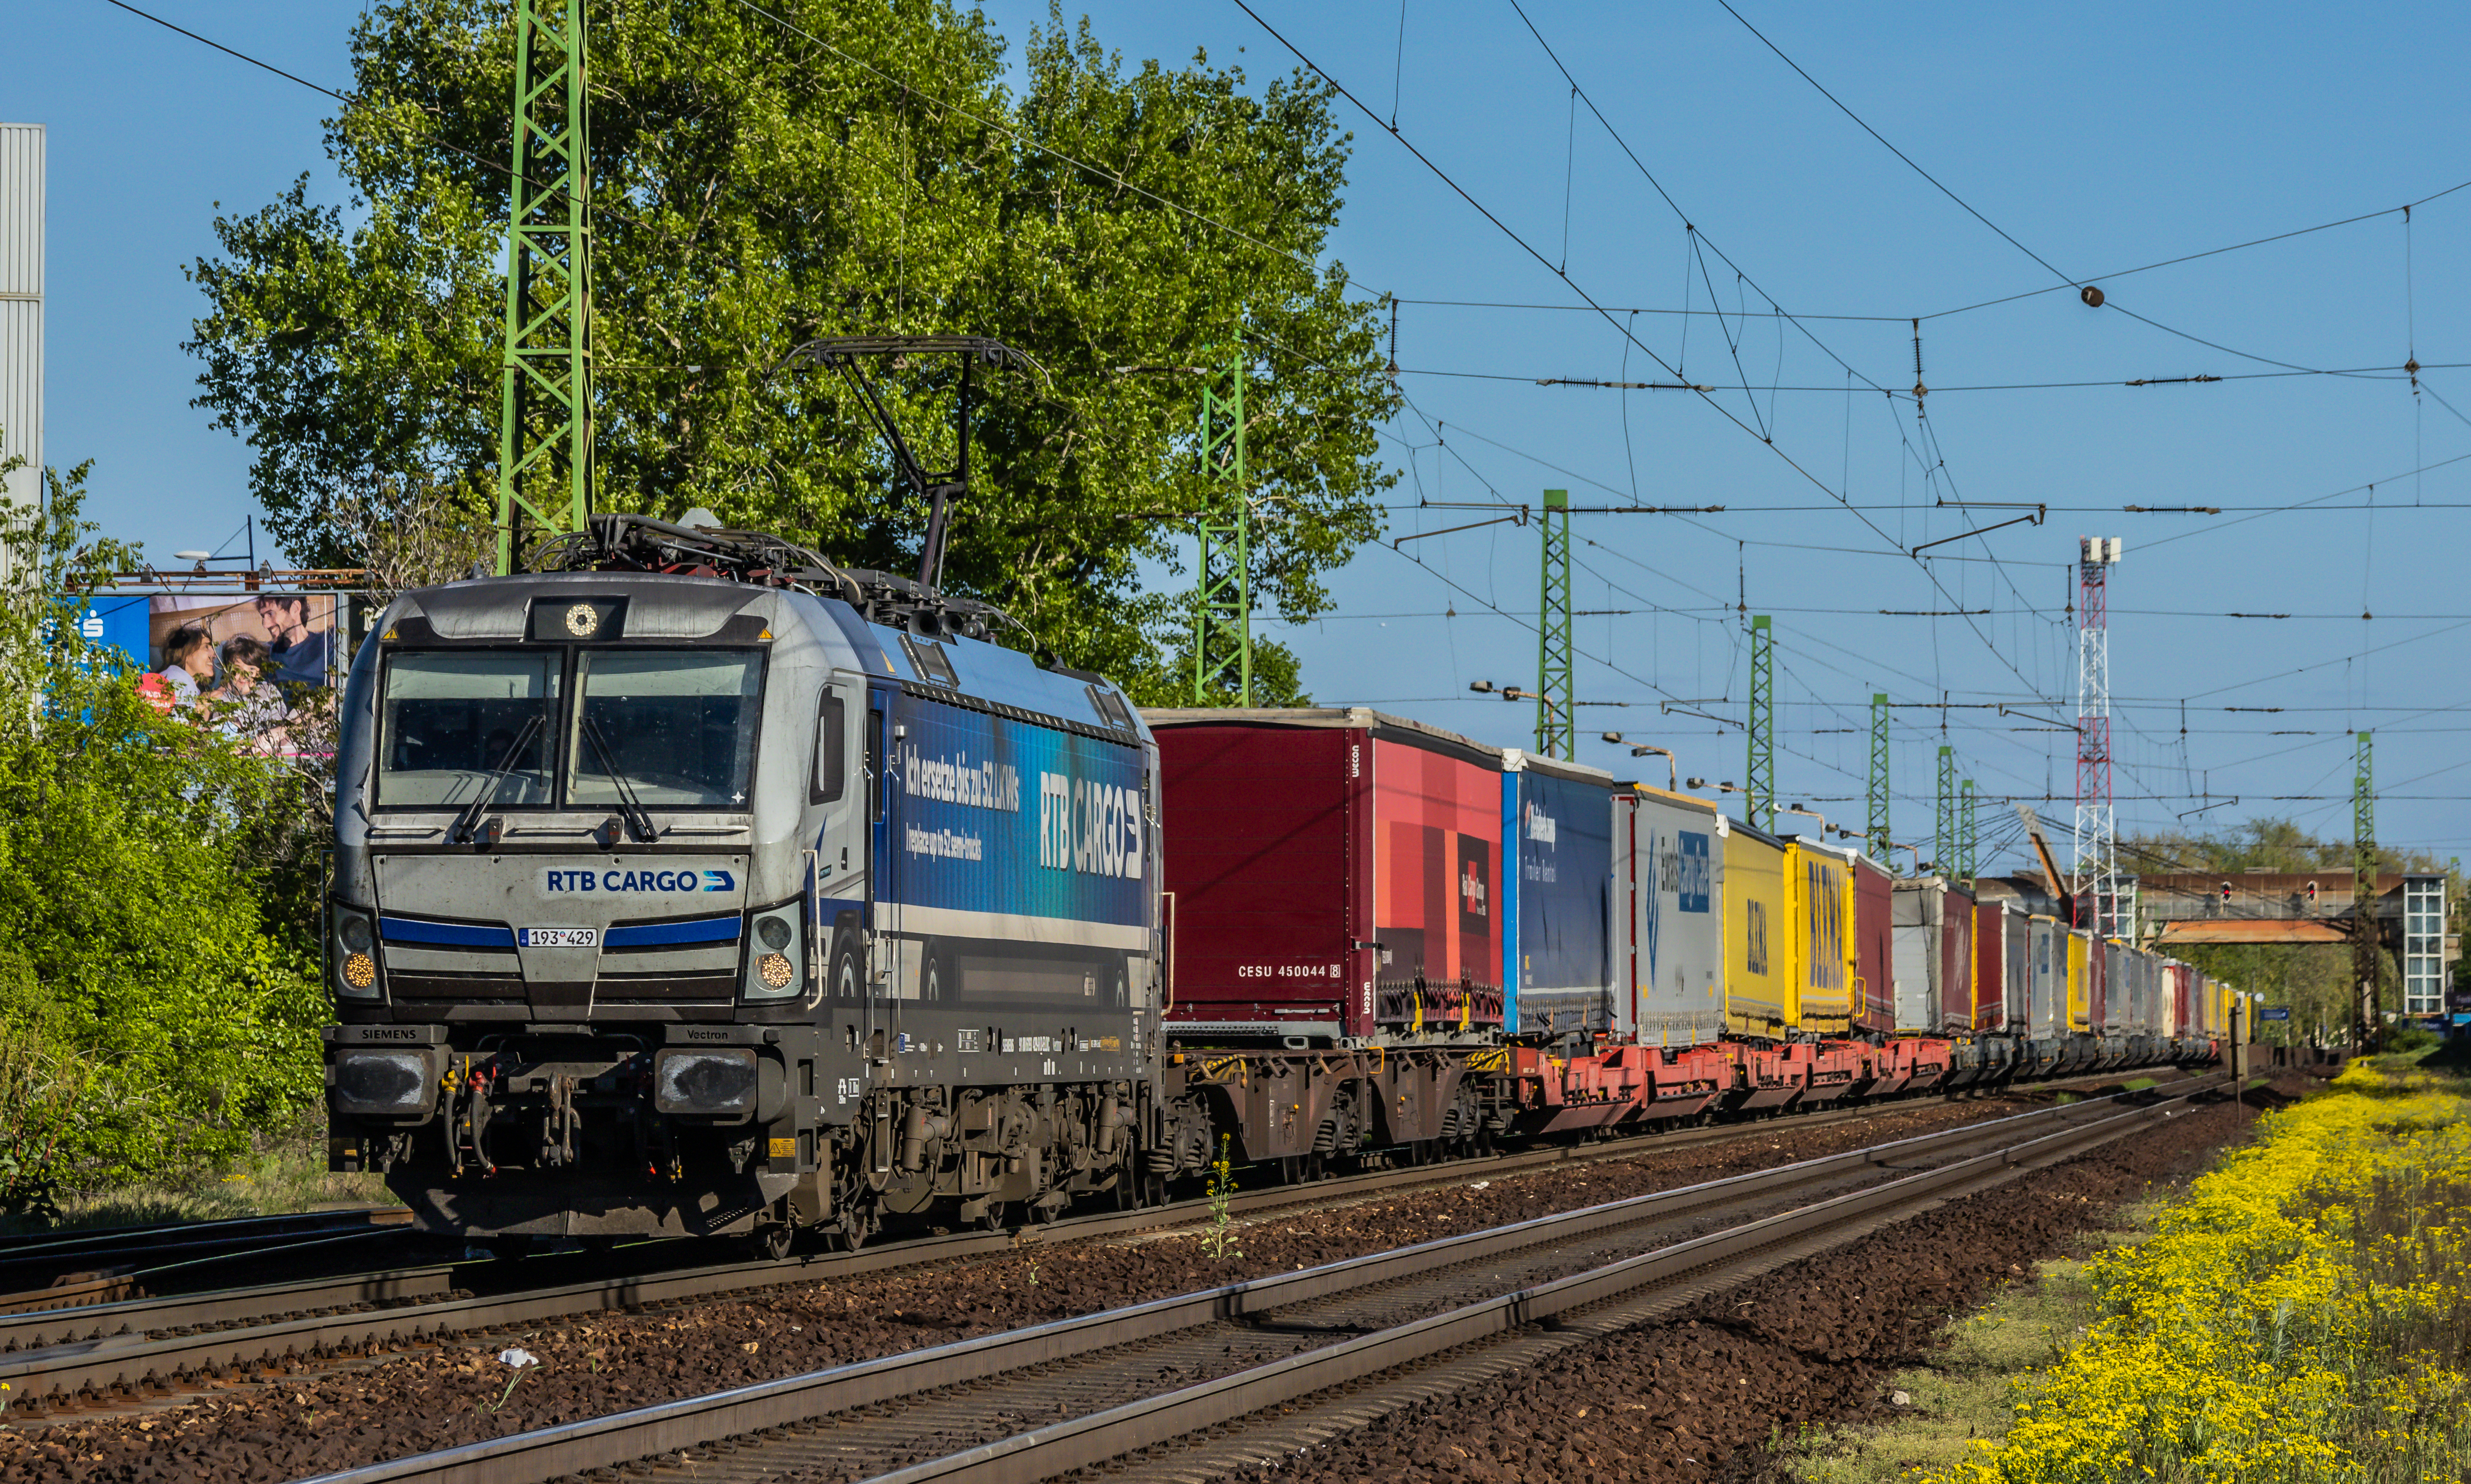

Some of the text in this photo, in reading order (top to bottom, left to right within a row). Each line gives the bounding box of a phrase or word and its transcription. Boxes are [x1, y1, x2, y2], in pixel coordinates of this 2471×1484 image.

[906, 744, 1019, 812] Ich ersetze bis zu 52 LKWs
[1040, 771, 1125, 878] RTB CARGO
[906, 822, 981, 863] I replace up to 52 semi-trucks
[547, 871, 698, 892] RTB CARGO
[531, 931, 593, 945] 193 429
[1239, 966, 1339, 977] CESU 450044 8
[362, 1029, 416, 1039] SIEMENS
[687, 1029, 728, 1039] Vectron
